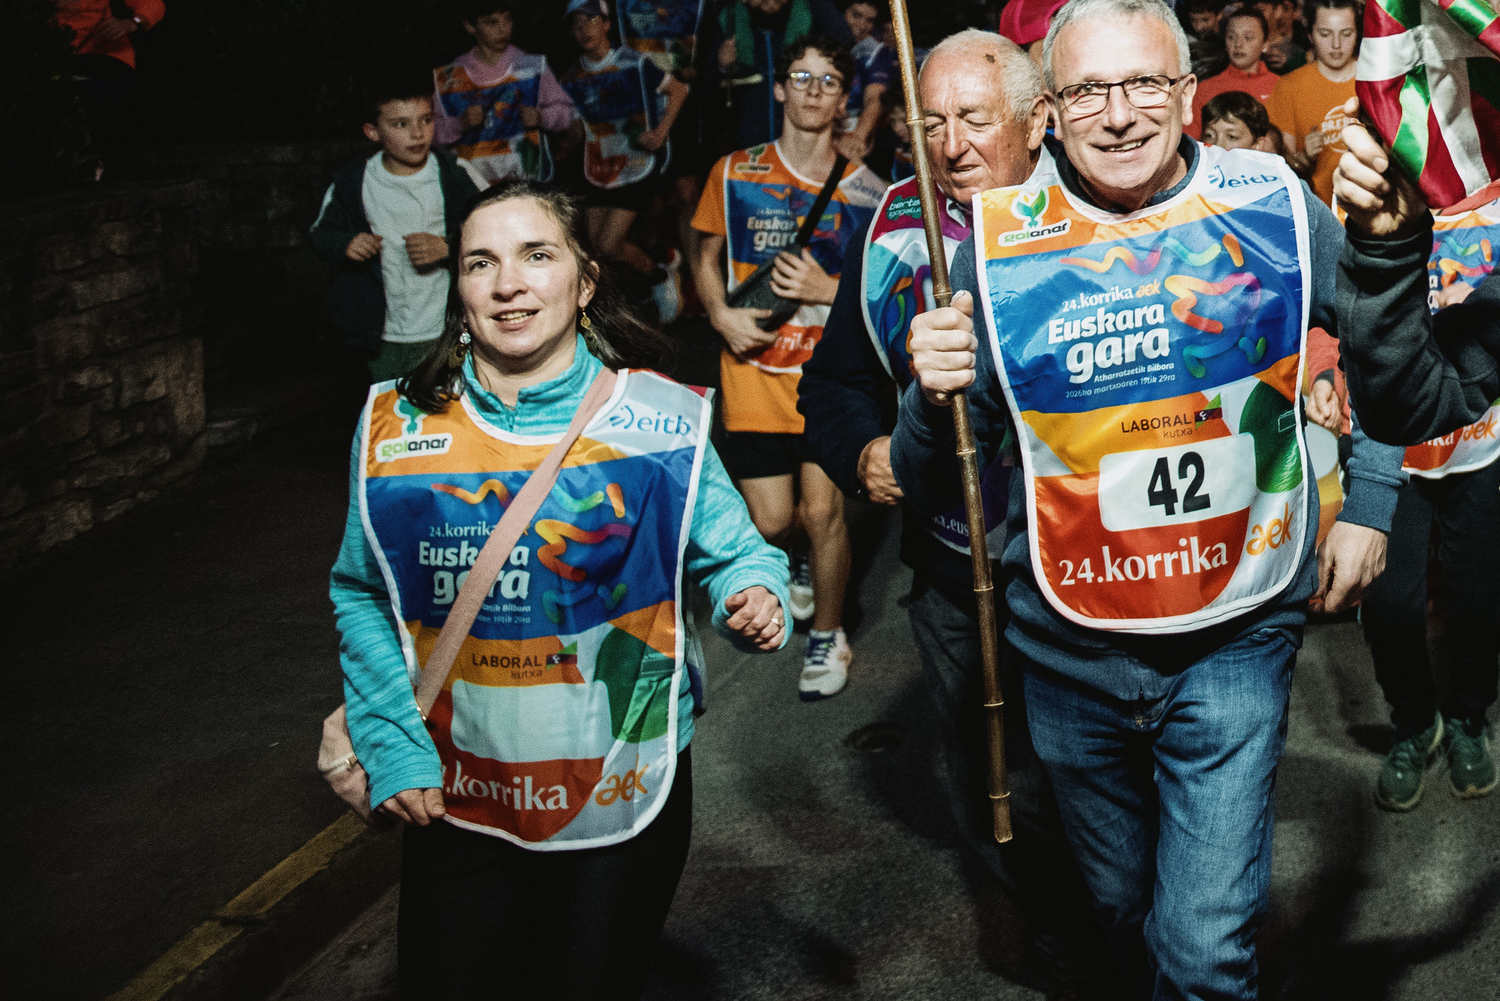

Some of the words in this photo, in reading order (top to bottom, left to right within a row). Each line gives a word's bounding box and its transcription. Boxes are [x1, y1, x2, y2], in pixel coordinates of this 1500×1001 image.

[1228, 172, 1278, 188] eitb
[747, 216, 796, 230] Euskar
[1004, 222, 1068, 243] goiener
[1061, 285, 1134, 313] 24.korrika
[1135, 278, 1161, 298] aek
[1048, 304, 1165, 345] Euskara
[1066, 328, 1170, 384] gara
[1094, 364, 1146, 383] Atharratzetik
[1147, 362, 1175, 373] Bilbora
[1065, 389, 1092, 398] 2026ko
[1094, 378, 1138, 395] martxoaren
[637, 411, 692, 436] eitb
[1121, 413, 1192, 433] LABORAL
[1163, 427, 1193, 439] kutxa
[1462, 412, 1498, 442] aek
[1147, 451, 1211, 517] 42
[1246, 502, 1294, 556] aek
[418, 540, 530, 567] Euska
[1059, 535, 1229, 586] 24.korrika
[472, 653, 542, 669] LABORAL
[442, 759, 569, 810] .korrika
[594, 753, 649, 807] aek
